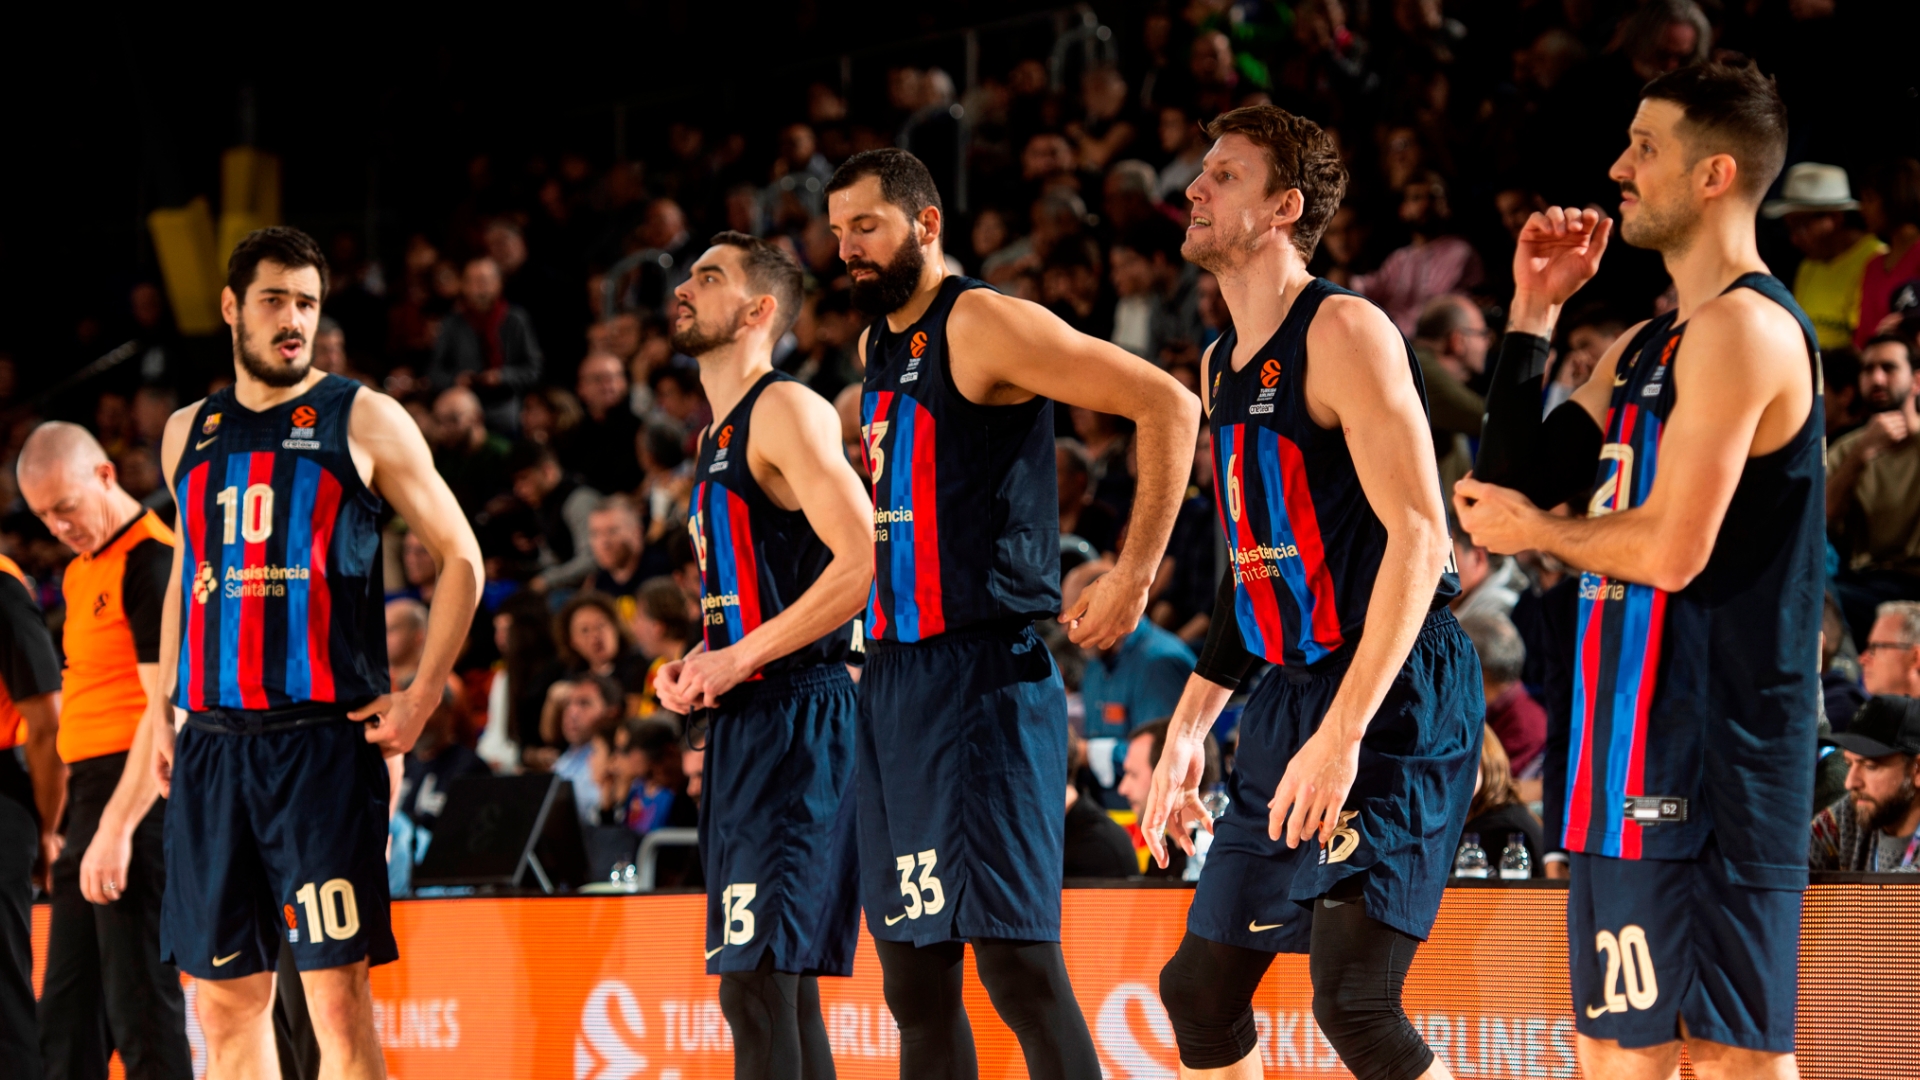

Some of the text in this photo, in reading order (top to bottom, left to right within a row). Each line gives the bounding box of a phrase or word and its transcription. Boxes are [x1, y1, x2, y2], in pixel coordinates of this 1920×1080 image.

[217, 484, 274, 544] 10
[1227, 454, 1241, 523] 6
[225, 564, 309, 581] Assistència
[225, 583, 285, 598] Sanitària
[296, 878, 360, 944] 10
[722, 883, 757, 946] 13
[896, 848, 946, 920] 33
[1596, 924, 1658, 1013] 20
[373, 998, 461, 1051] RLINES
